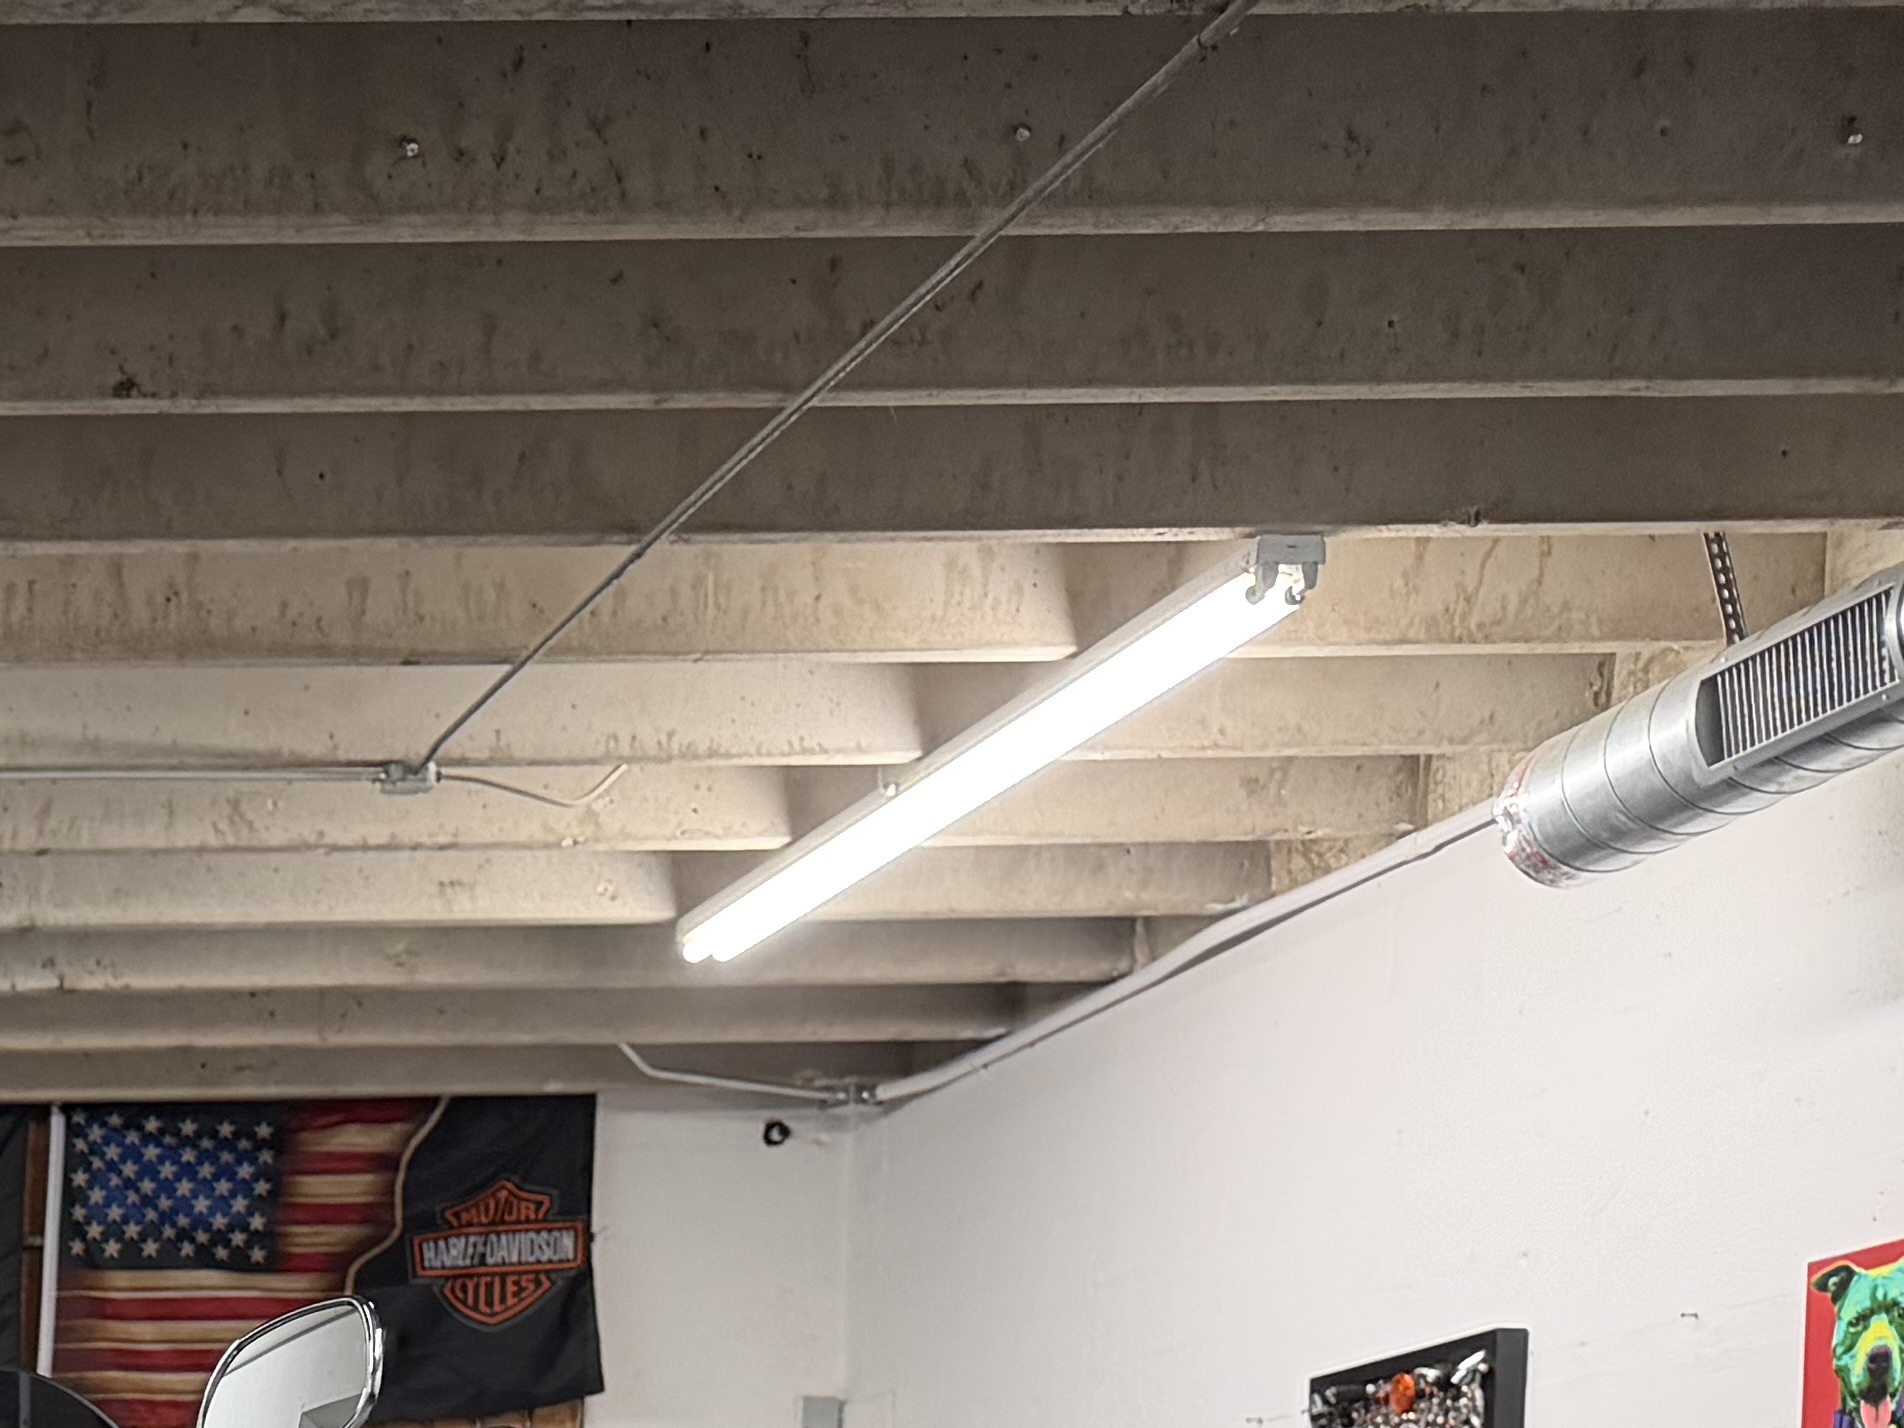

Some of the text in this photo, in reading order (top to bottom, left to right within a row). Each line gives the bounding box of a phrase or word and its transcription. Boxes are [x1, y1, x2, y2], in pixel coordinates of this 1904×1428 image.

[460, 1187, 537, 1225] MOTOR
[422, 1228, 575, 1269] HARLEY-DAVIDSON
[454, 1273, 537, 1314] CYCLES
